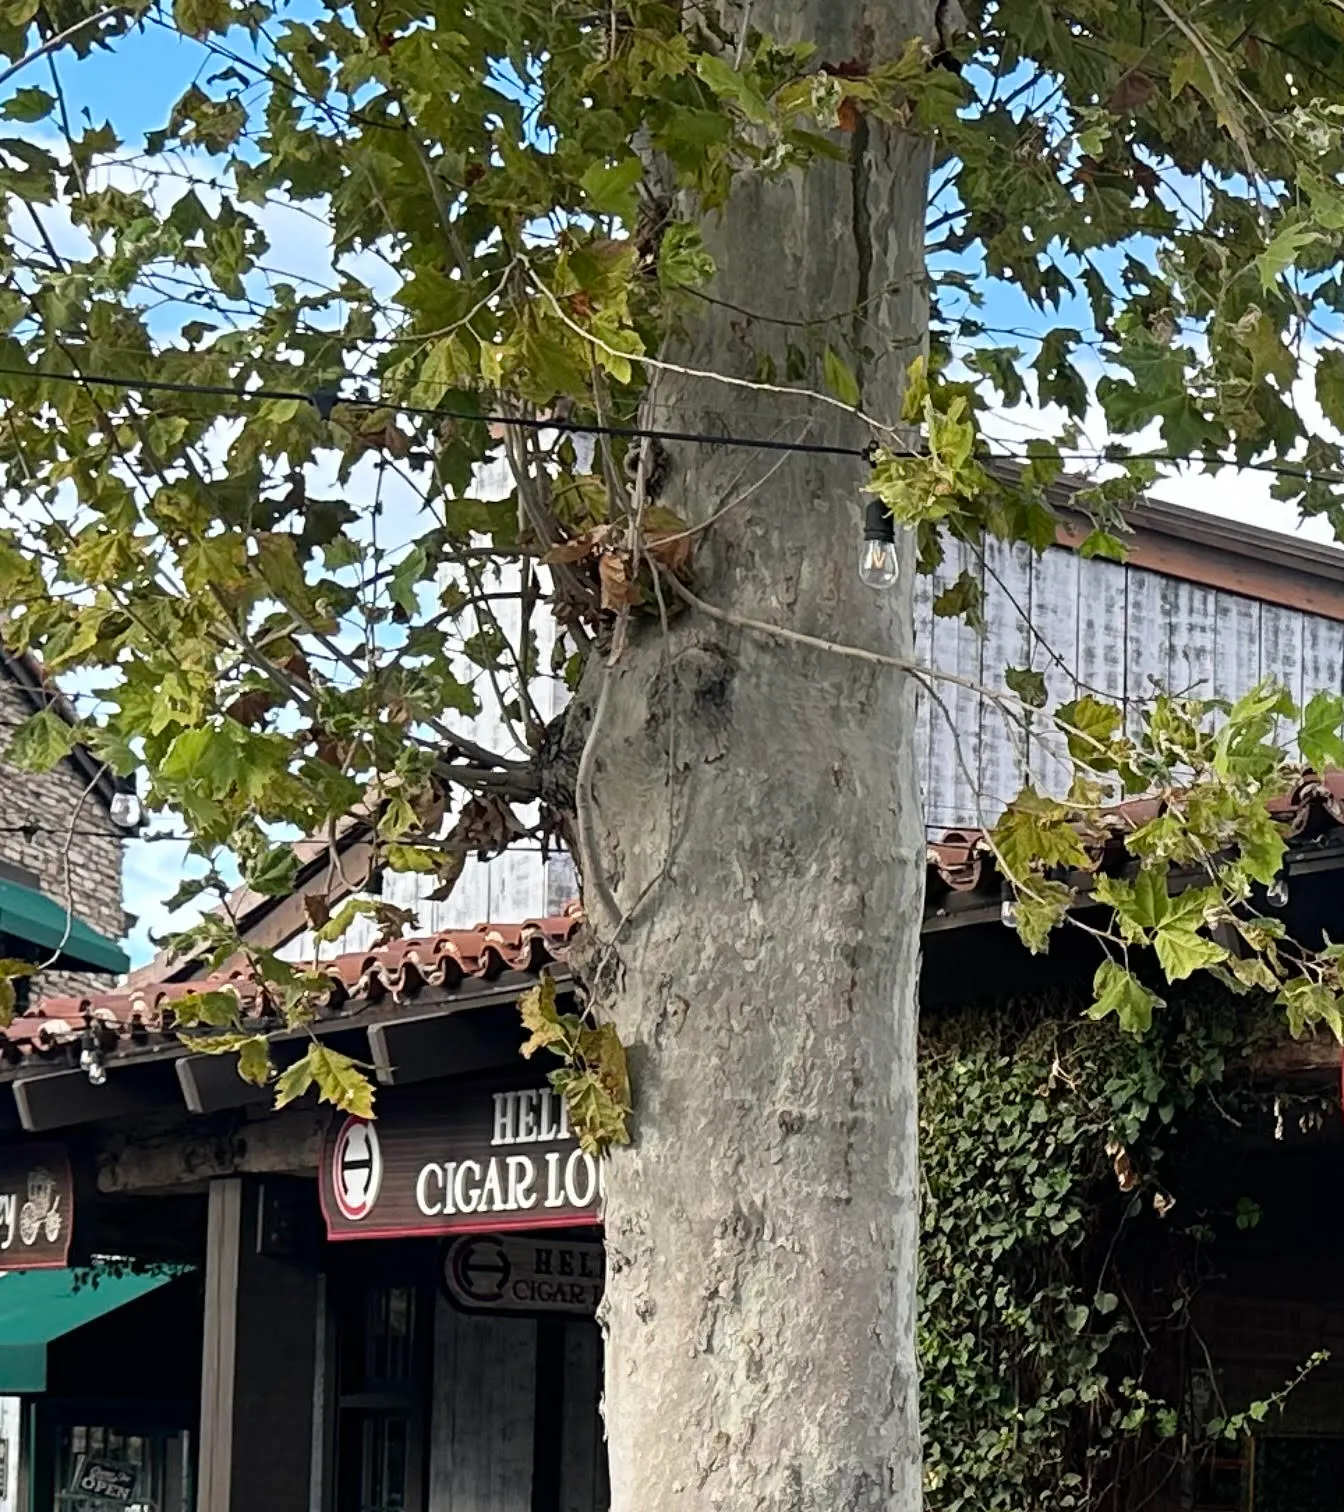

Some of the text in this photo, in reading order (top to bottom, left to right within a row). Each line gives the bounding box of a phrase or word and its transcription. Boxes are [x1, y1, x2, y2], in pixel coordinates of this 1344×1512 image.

[490, 1087, 571, 1146] HELI
[416, 1155, 538, 1216] CIGAR
[512, 1280, 586, 1304] CIGAR
[81, 1476, 131, 1500] OPEN
